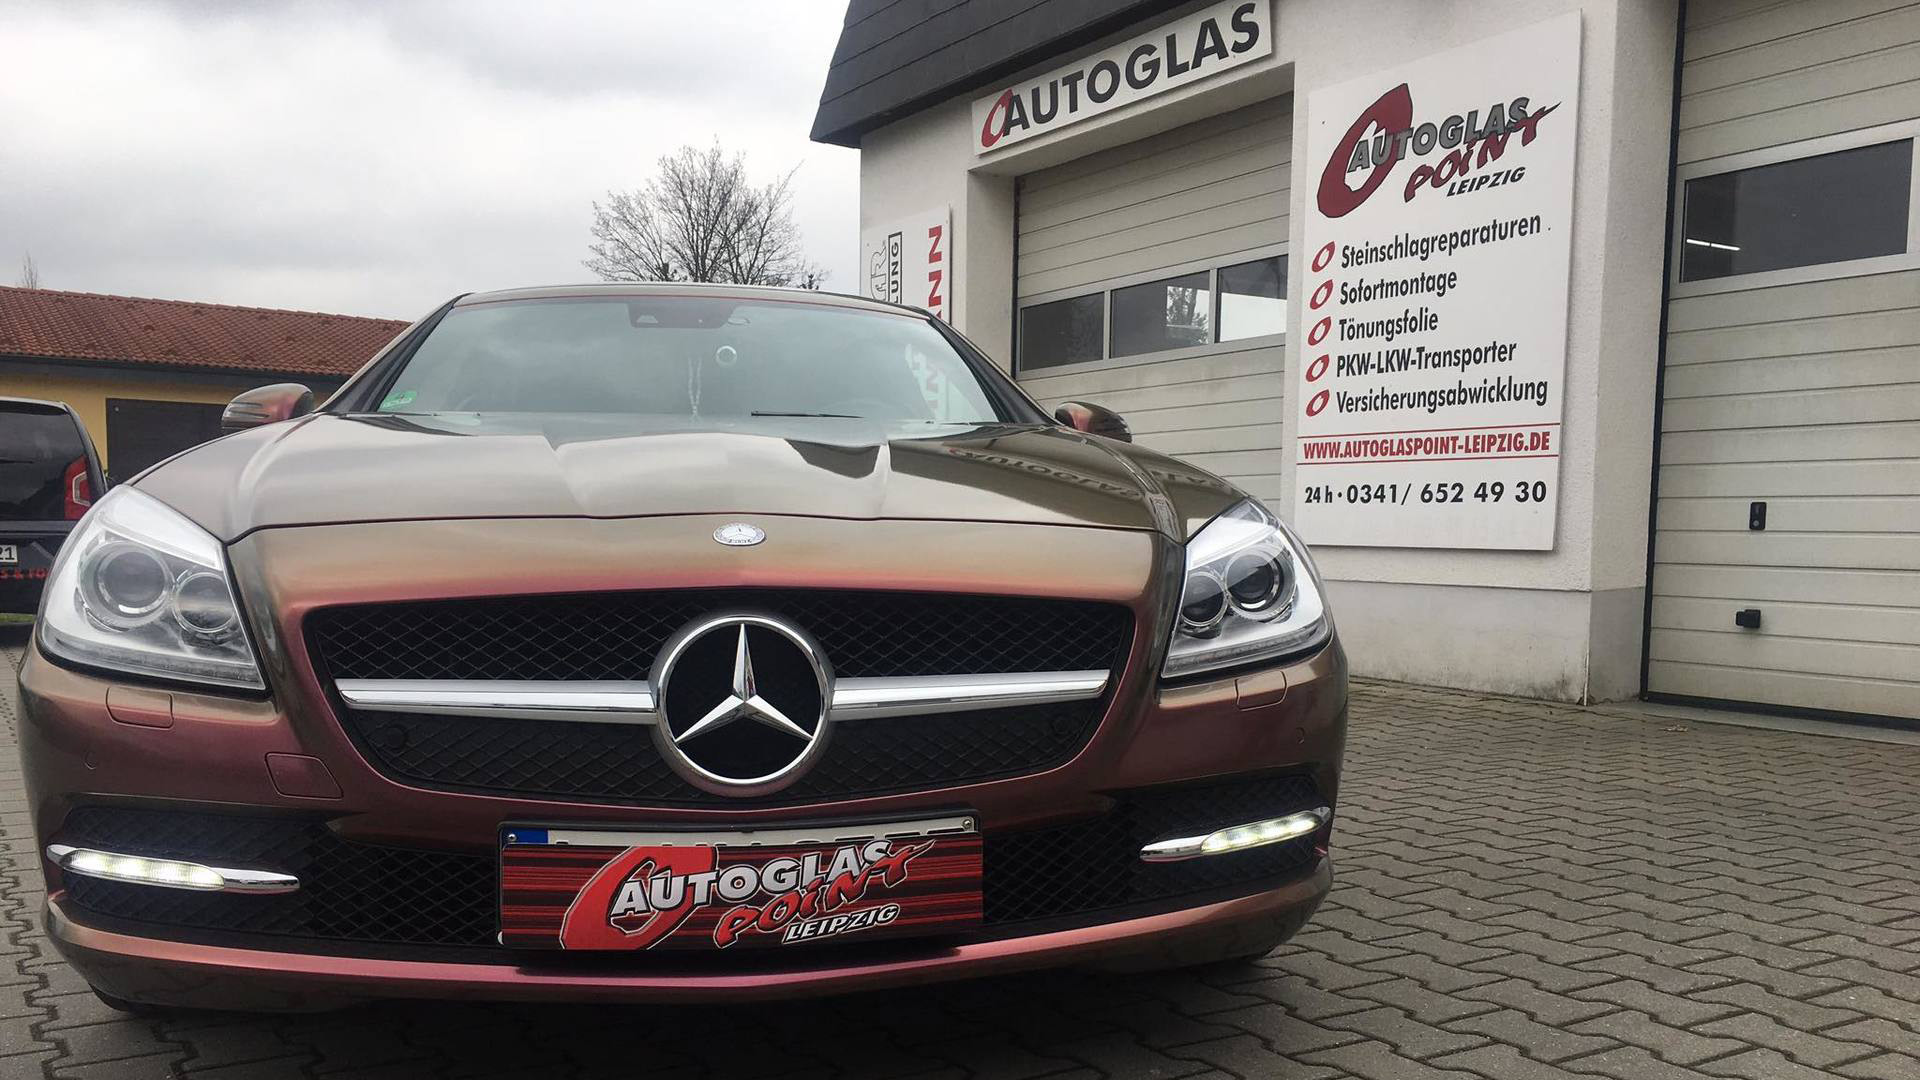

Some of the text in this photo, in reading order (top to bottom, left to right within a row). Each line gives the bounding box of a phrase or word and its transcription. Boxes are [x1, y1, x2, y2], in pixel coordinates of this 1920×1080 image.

[1003, 3, 1260, 137] AUTOGLAS
[1347, 97, 1531, 173] AUTOGLAS
[1447, 167, 1527, 197] LEIPZIG
[1341, 214, 1541, 268] Steinschlagreparaturen
[1339, 271, 1457, 305] Sofortmontage
[1339, 307, 1438, 341] Tönungsfolie
[1336, 341, 1517, 377] PKW-LKW-Transporter
[1336, 376, 1548, 413] Versicherungsabwicklung
[1303, 431, 1550, 459] WWW.AUTOGLASPOINT-LEIPZIG.DE
[1305, 486, 1321, 503] 24
[1324, 485, 1333, 503] h
[1420, 482, 1464, 503] 652
[1474, 481, 1504, 503] 49
[1515, 480, 1547, 503] 30
[610, 840, 893, 917] AUTOGLAS
[783, 903, 900, 943] LEIPZIG
